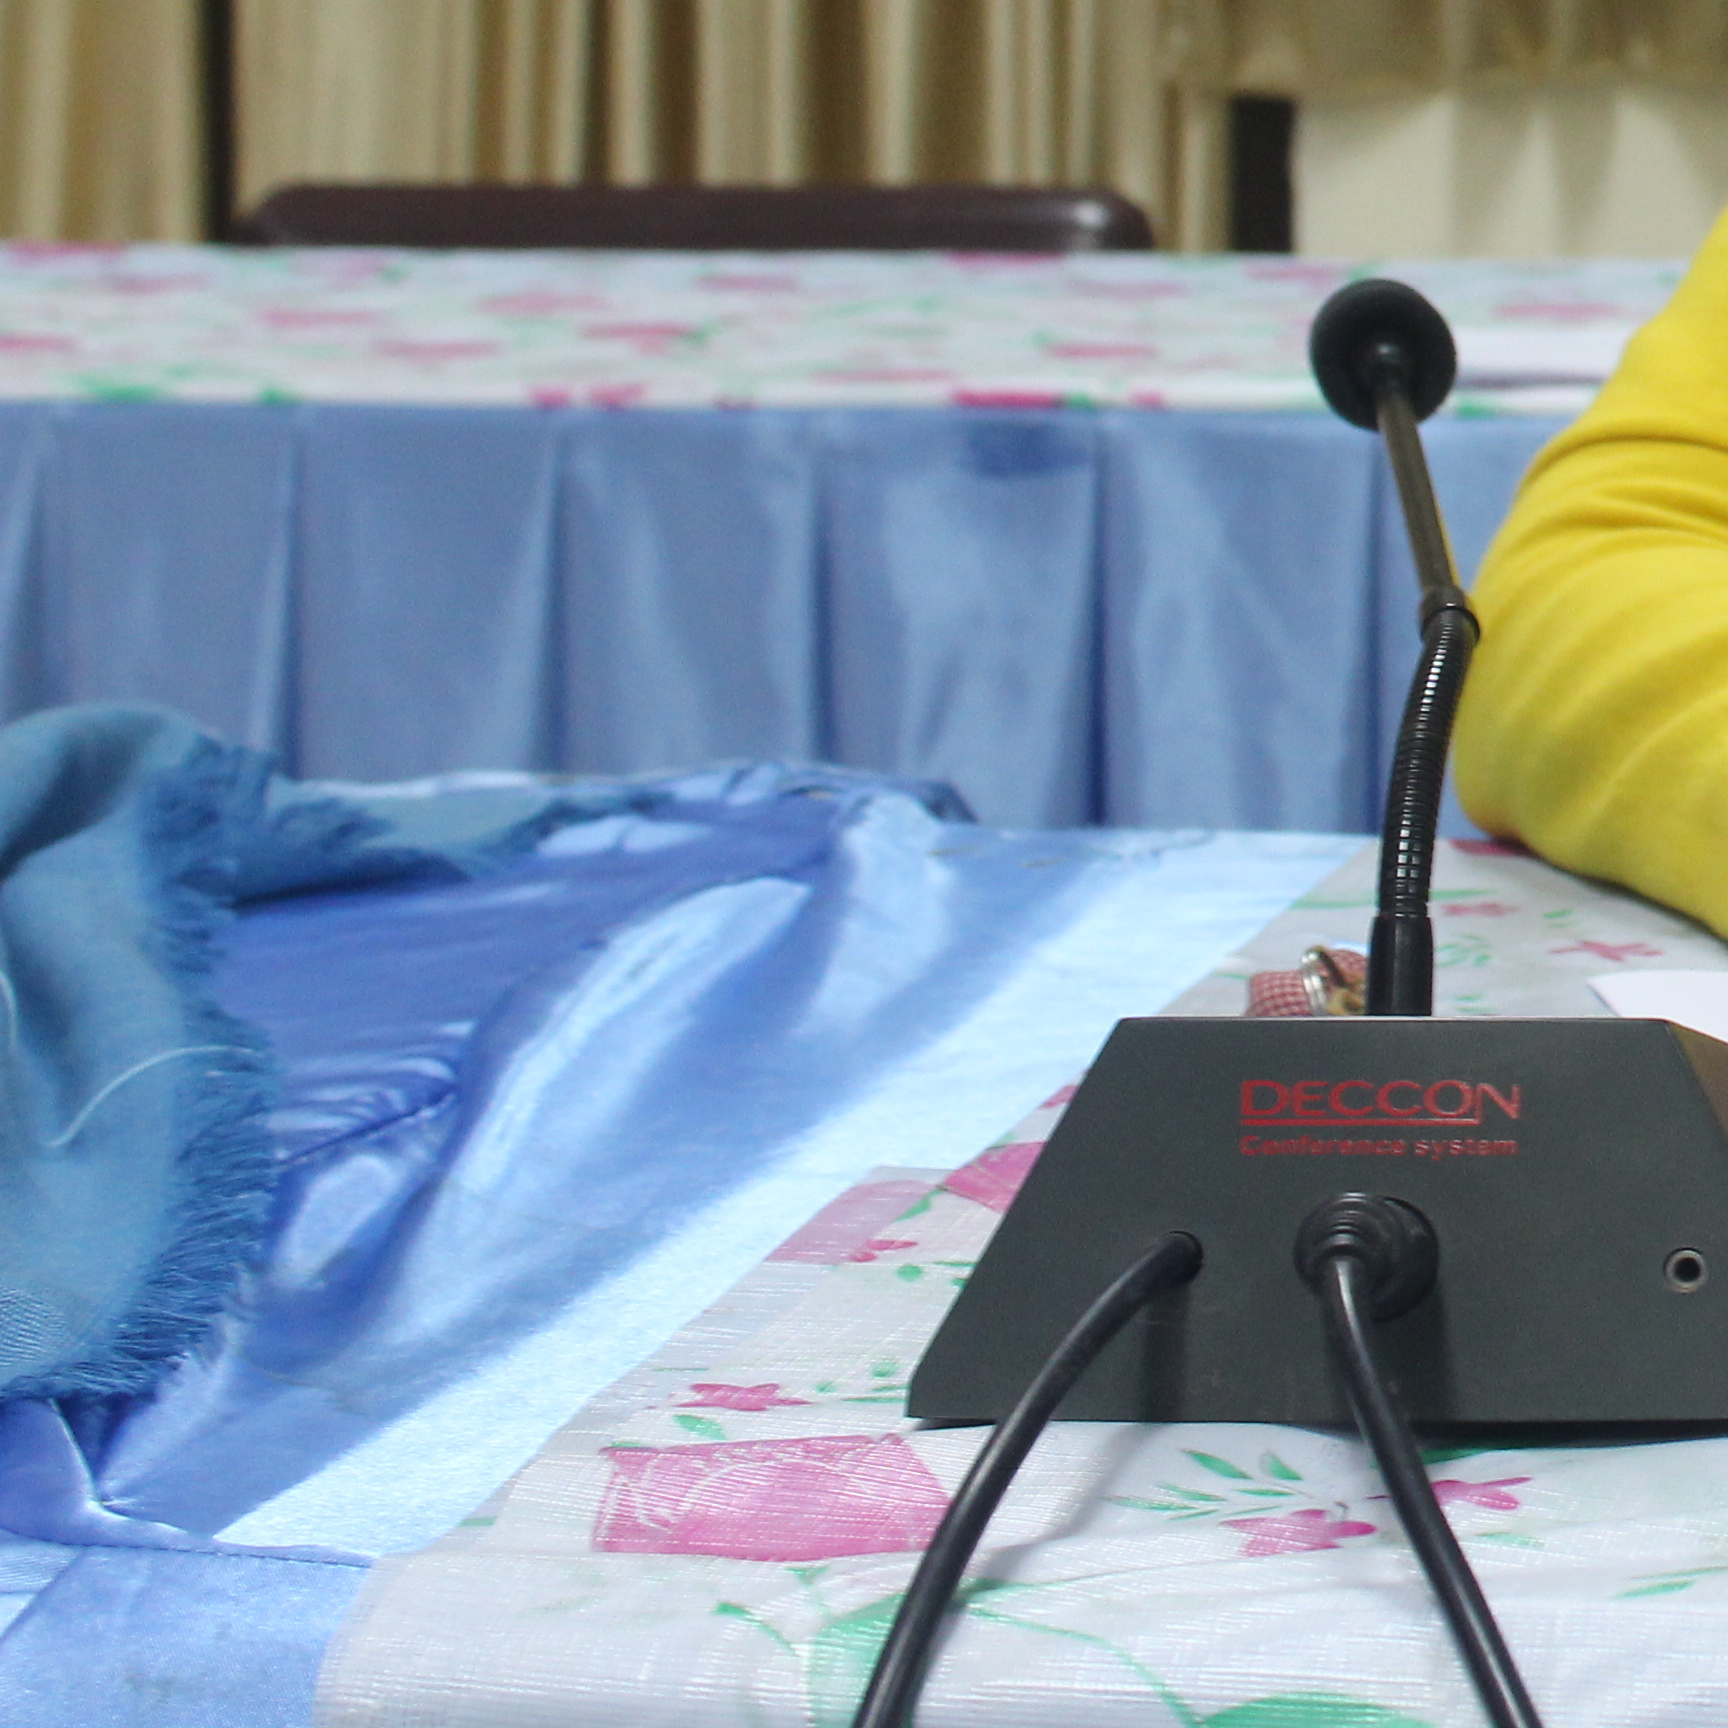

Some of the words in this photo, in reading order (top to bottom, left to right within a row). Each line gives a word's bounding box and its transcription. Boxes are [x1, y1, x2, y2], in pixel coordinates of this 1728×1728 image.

[1240, 1079, 1521, 1125] DECCON
[1239, 1134, 1406, 1156] Conference
[1414, 1138, 1518, 1161] system
